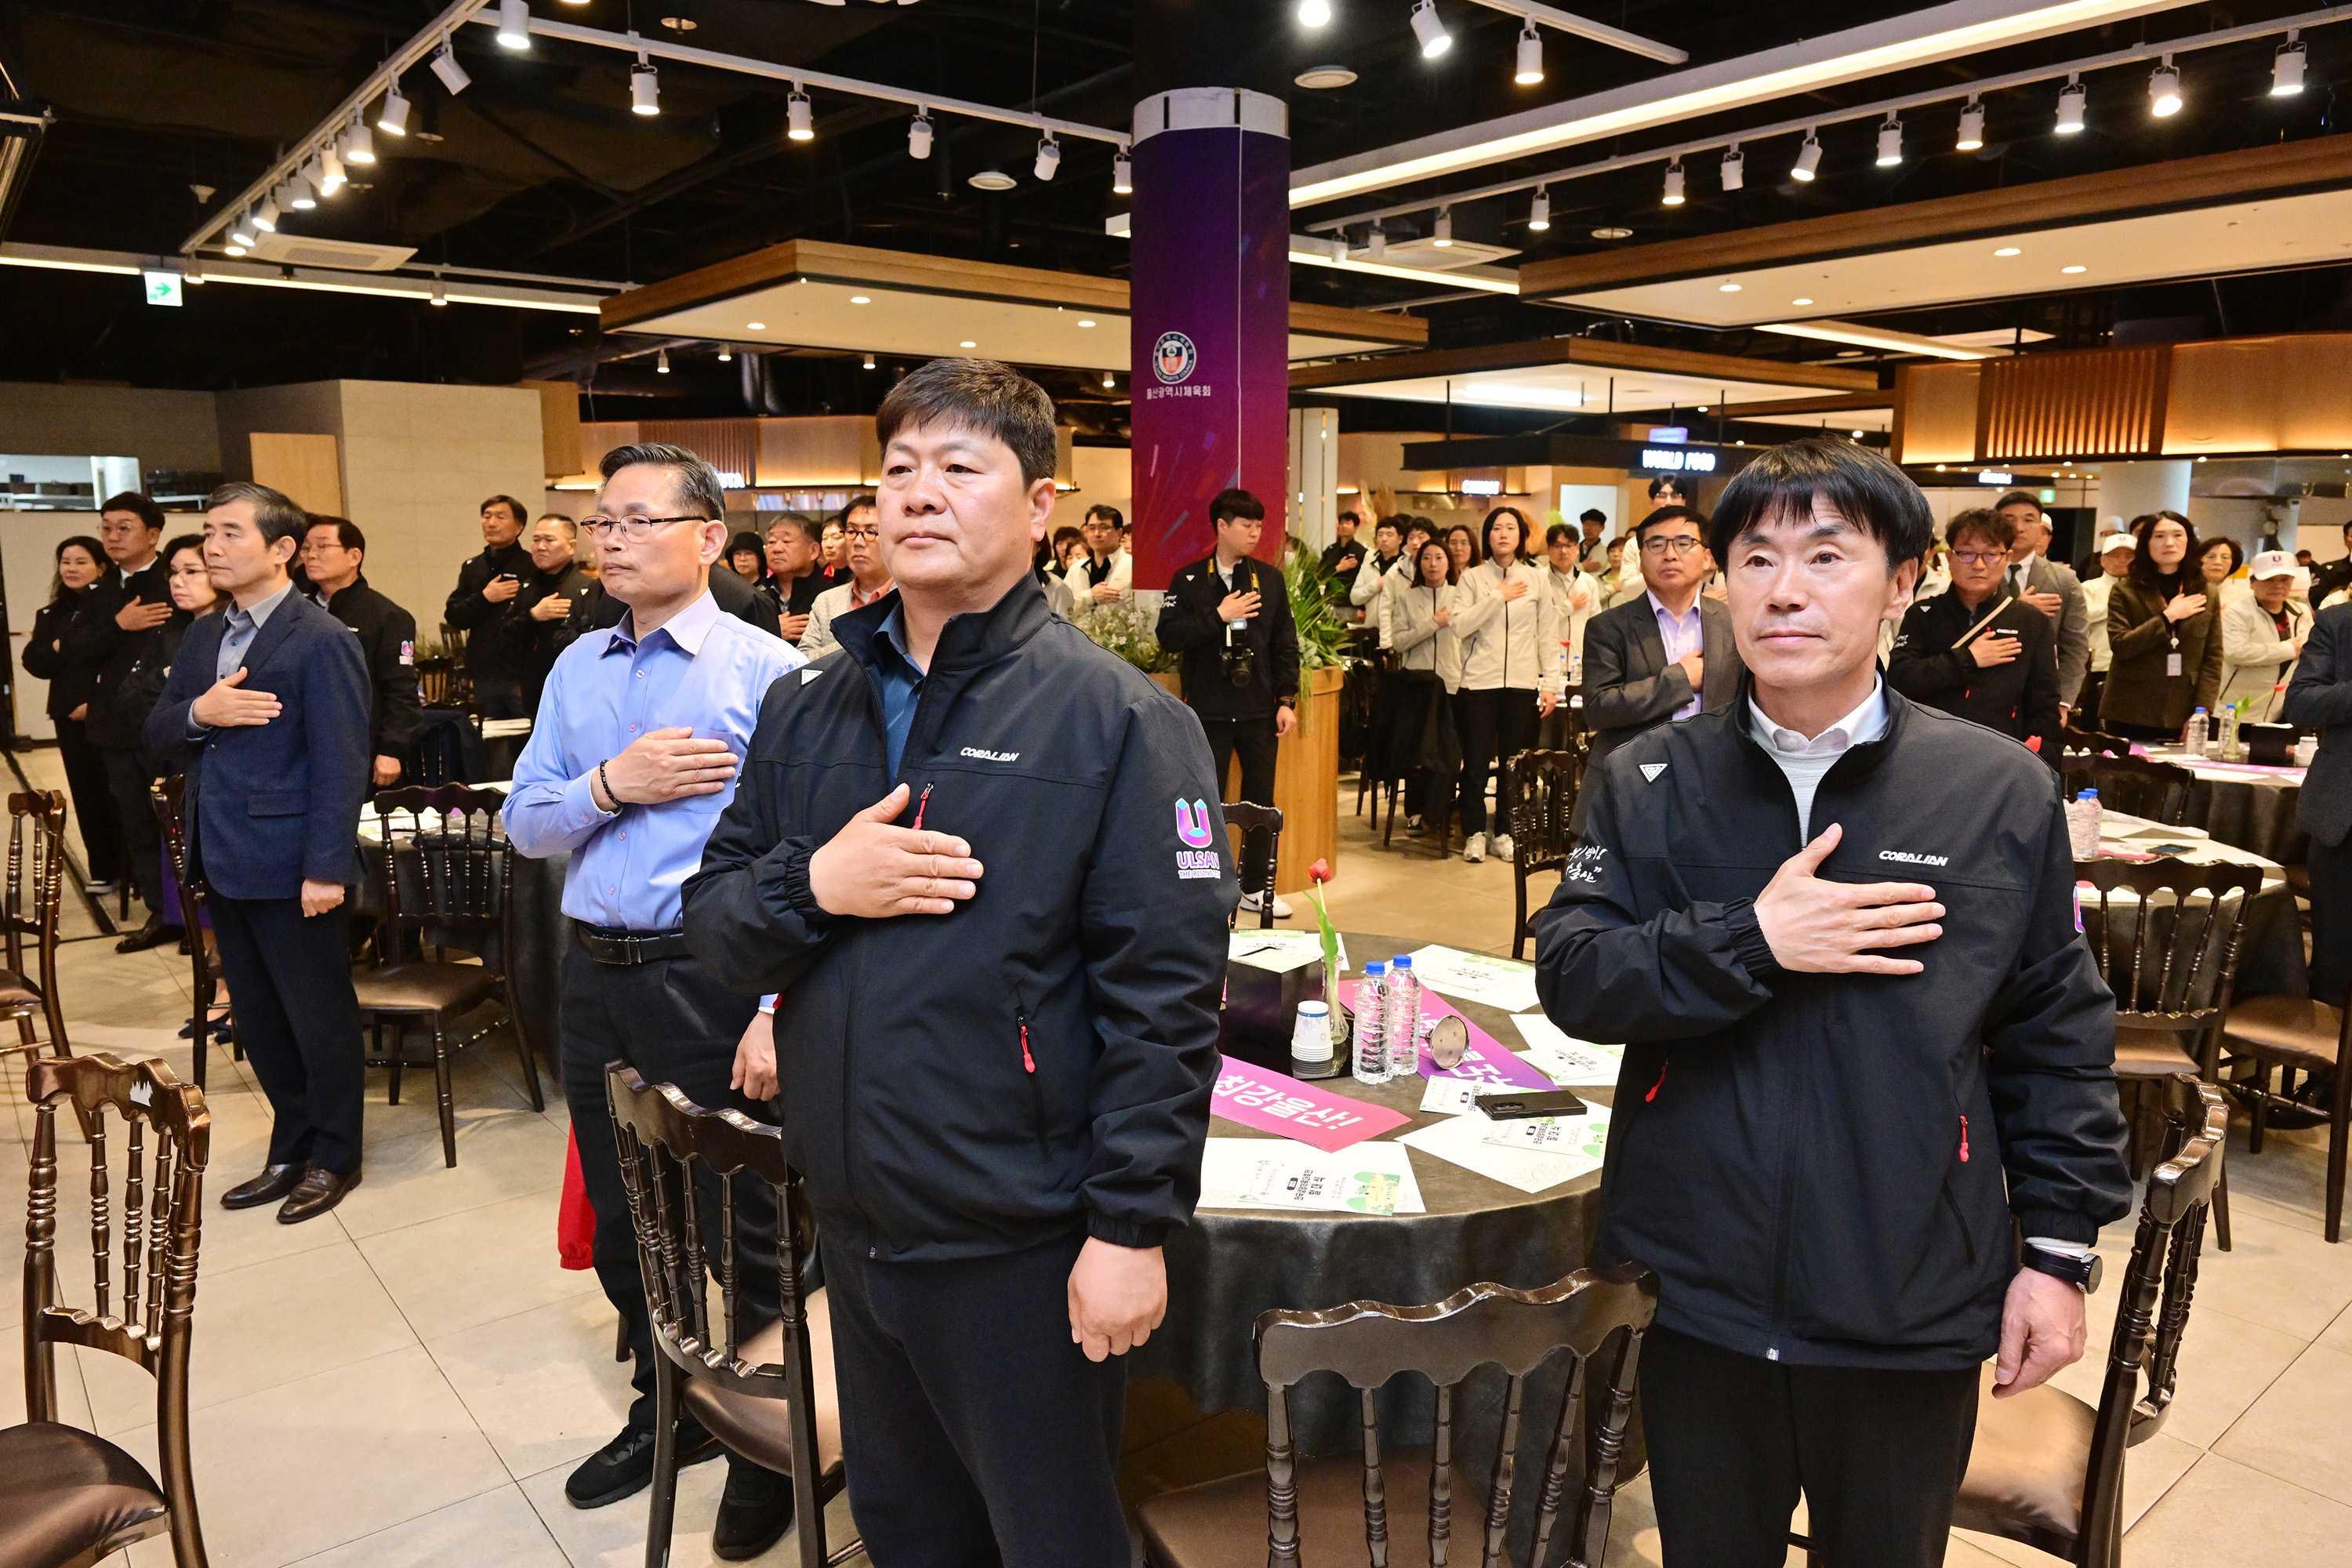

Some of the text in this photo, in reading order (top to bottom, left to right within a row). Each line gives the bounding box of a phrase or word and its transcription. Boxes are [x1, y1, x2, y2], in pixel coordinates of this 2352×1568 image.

[1146, 385, 1210, 400] 울산광역시체육회
[960, 746, 1019, 762] CORALIAN
[1176, 851, 1220, 869] ULSAN
[1878, 850, 1949, 866] CORALIAN
[1178, 869, 1192, 879] THE
[1192, 869, 1213, 878] RISING
